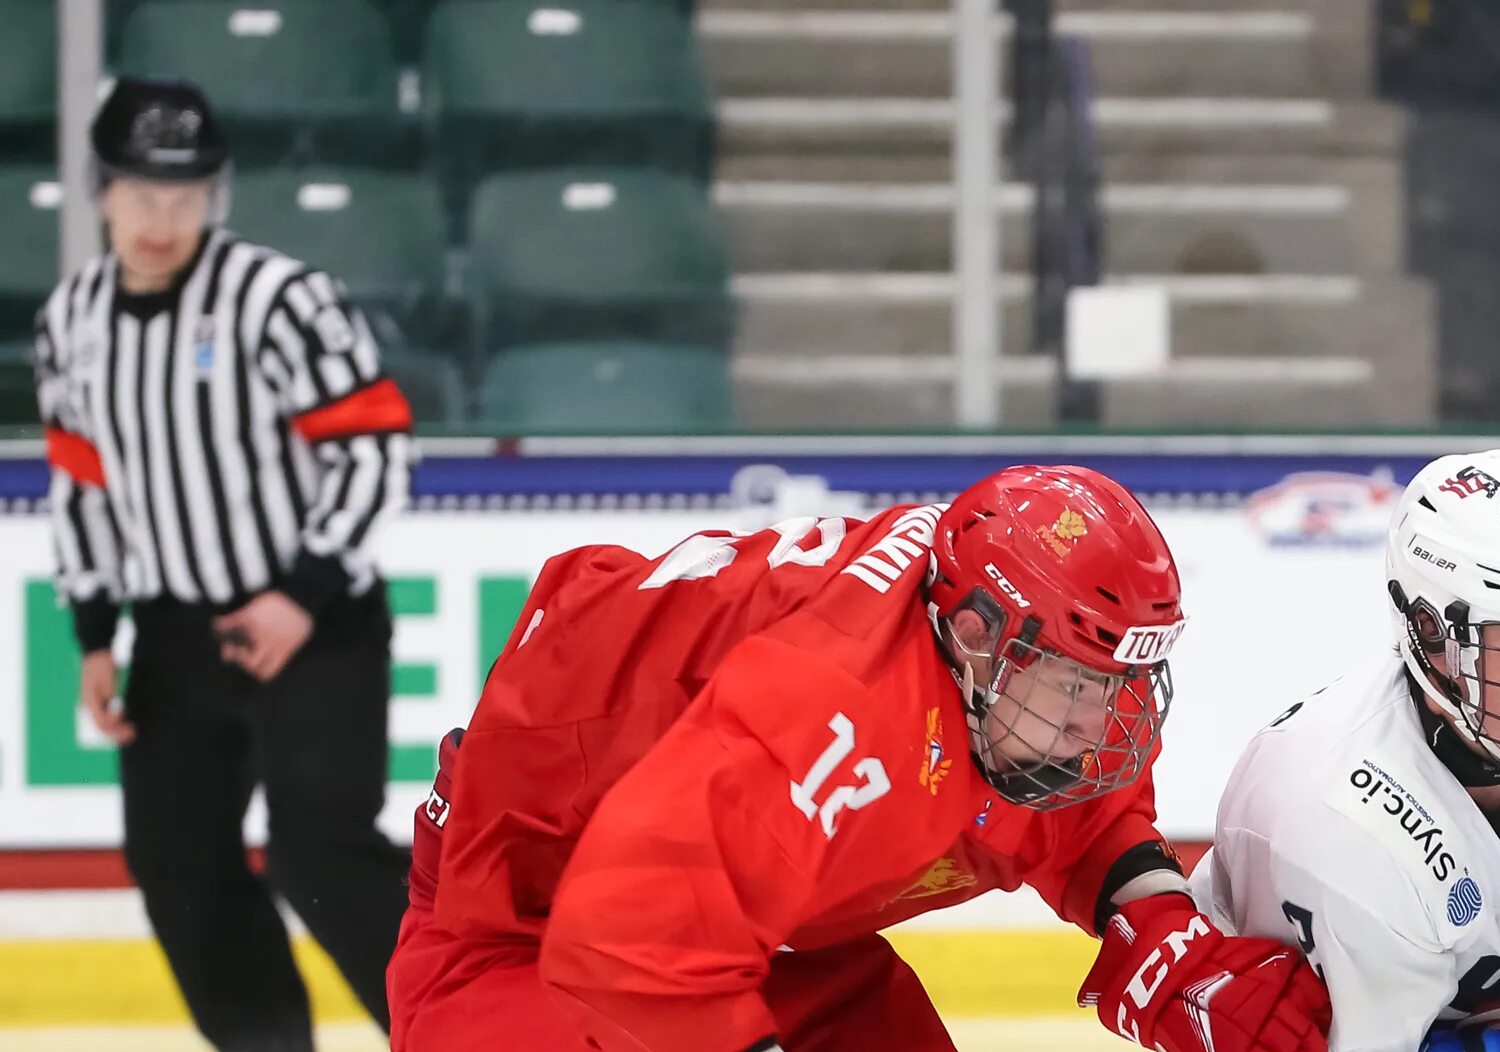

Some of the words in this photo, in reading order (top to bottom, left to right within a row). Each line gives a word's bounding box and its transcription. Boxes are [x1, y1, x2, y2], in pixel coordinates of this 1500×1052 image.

[984, 561, 1031, 608] CCM
[790, 711, 892, 840] 12
[1350, 768, 1456, 882] Slync.io
[1117, 915, 1211, 1044] CCM
